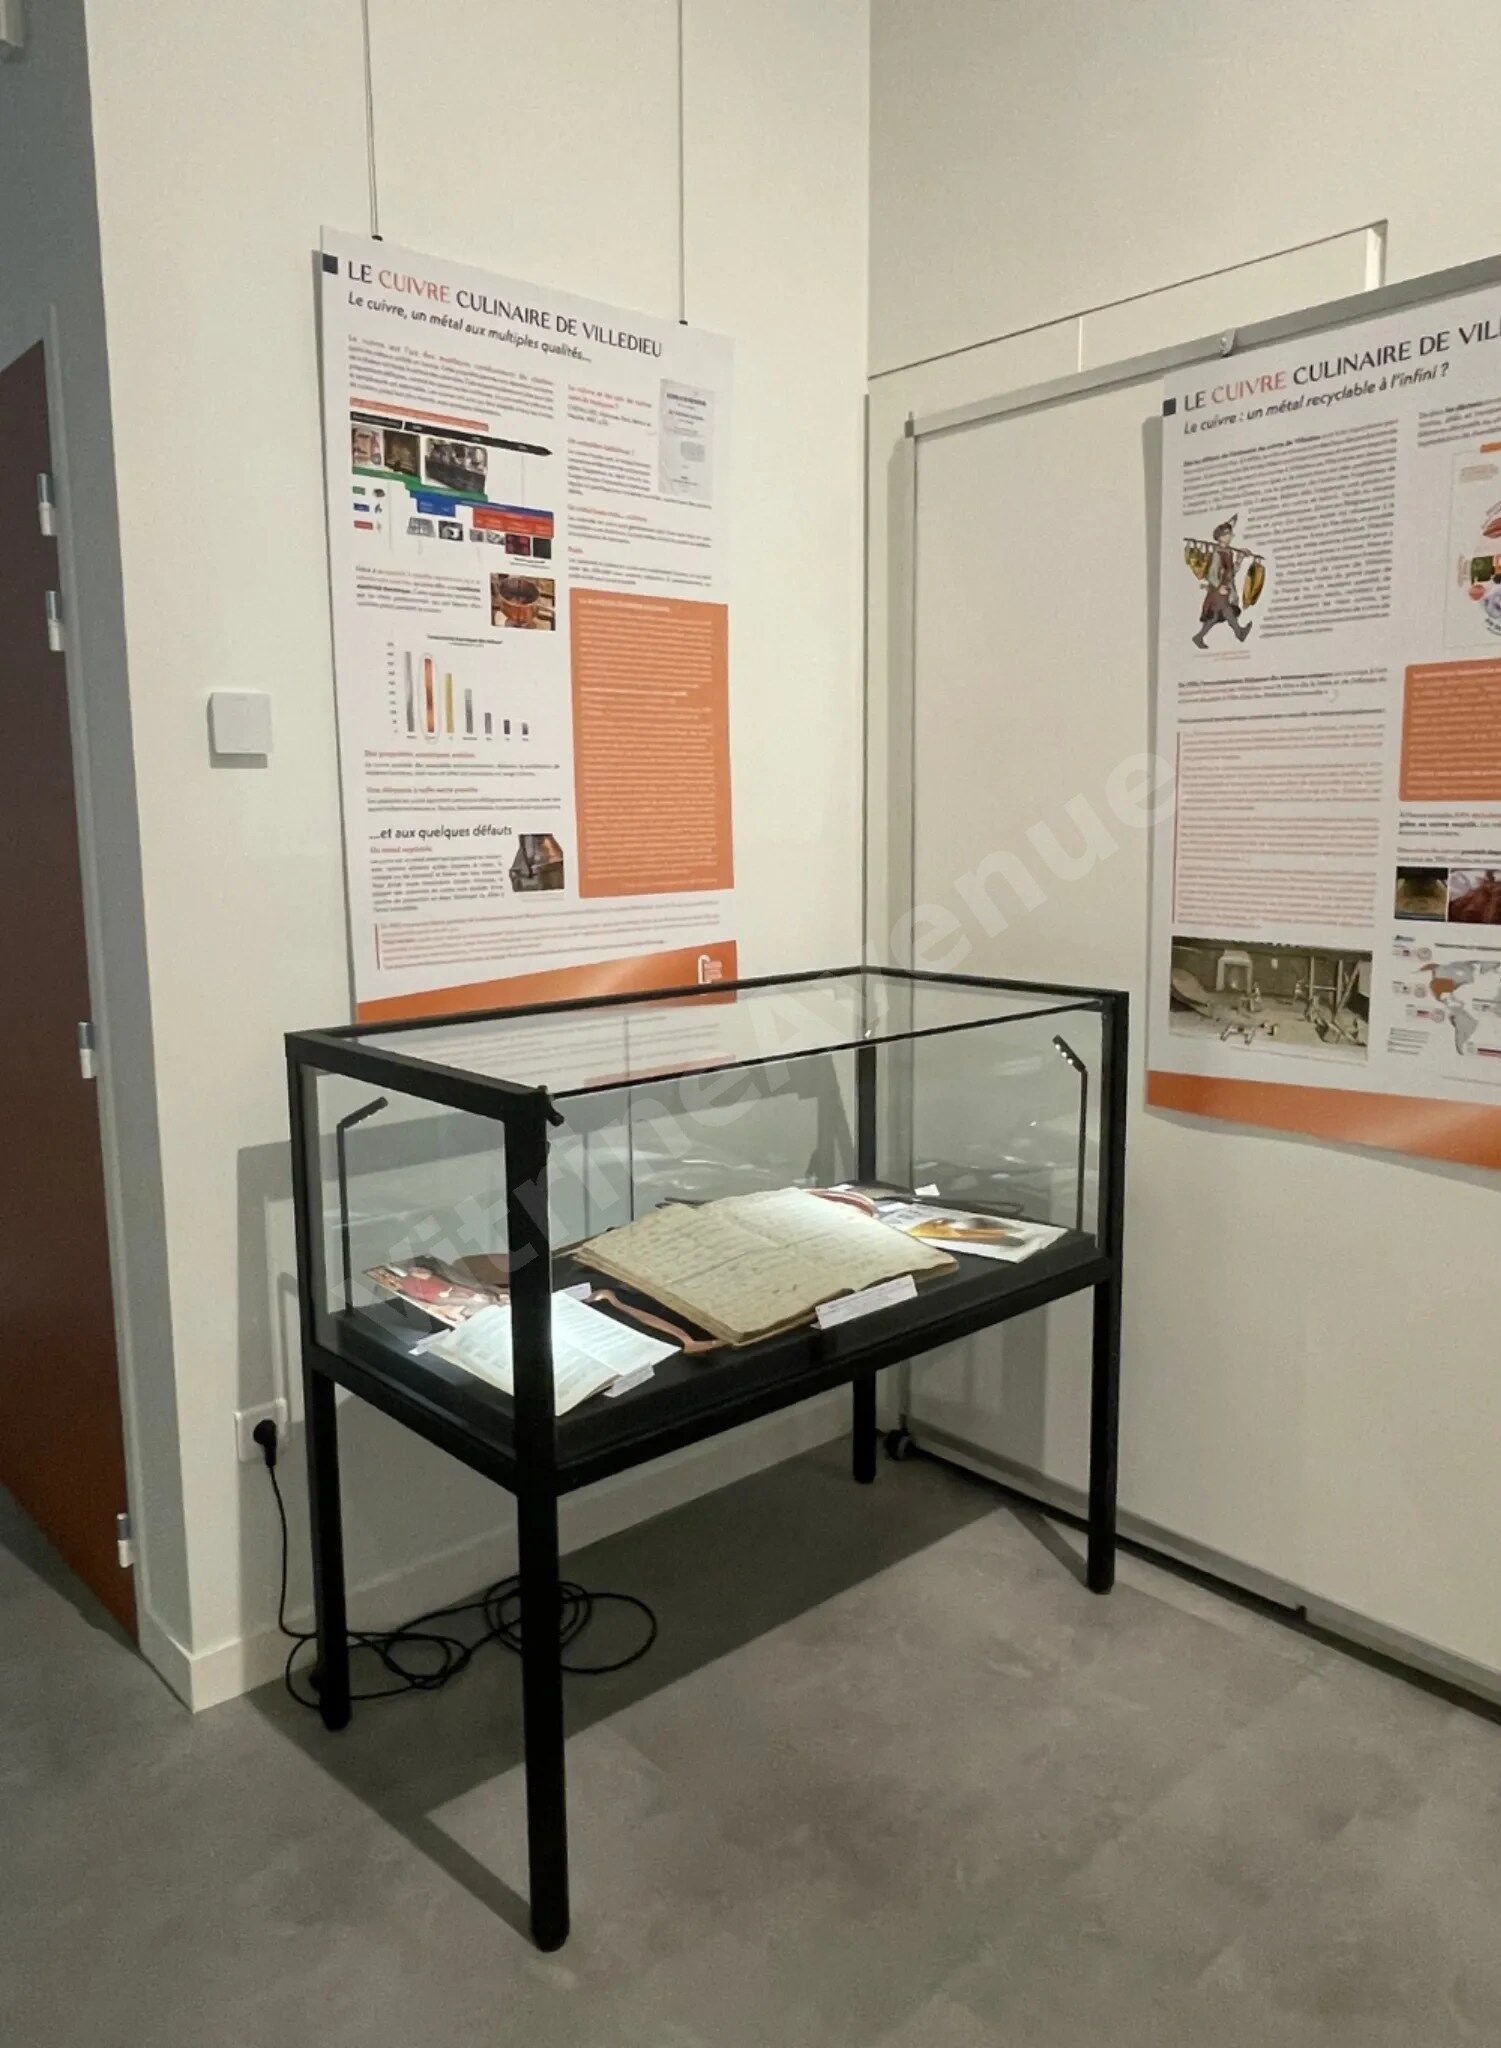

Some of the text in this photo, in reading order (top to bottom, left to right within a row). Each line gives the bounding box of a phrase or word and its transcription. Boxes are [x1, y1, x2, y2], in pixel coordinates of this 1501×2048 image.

[348, 261, 662, 358] LE CUIVRE CULINAIRE DE VILLEDIEU
[348, 292, 364, 307] Le
[367, 299, 408, 320] cuivre,
[410, 309, 427, 321] un
[429, 314, 464, 331] métal
[464, 323, 486, 338] aux
[487, 329, 539, 349] multiples
[1184, 318, 1501, 410] LE CUIVRE CULINAIRE DE VIL
[1184, 421, 1197, 434] Le
[1200, 414, 1236, 431] cuivre
[1247, 408, 1263, 420] un
[1266, 395, 1304, 416] métal
[1306, 380, 1376, 407] recyclable
[1379, 376, 1387, 391] à
[1390, 363, 1438, 390] l'infini
[1440, 361, 1450, 377] ?
[395, 830, 415, 839] aux
[418, 824, 470, 841] quelques
[472, 823, 513, 837] défauts
